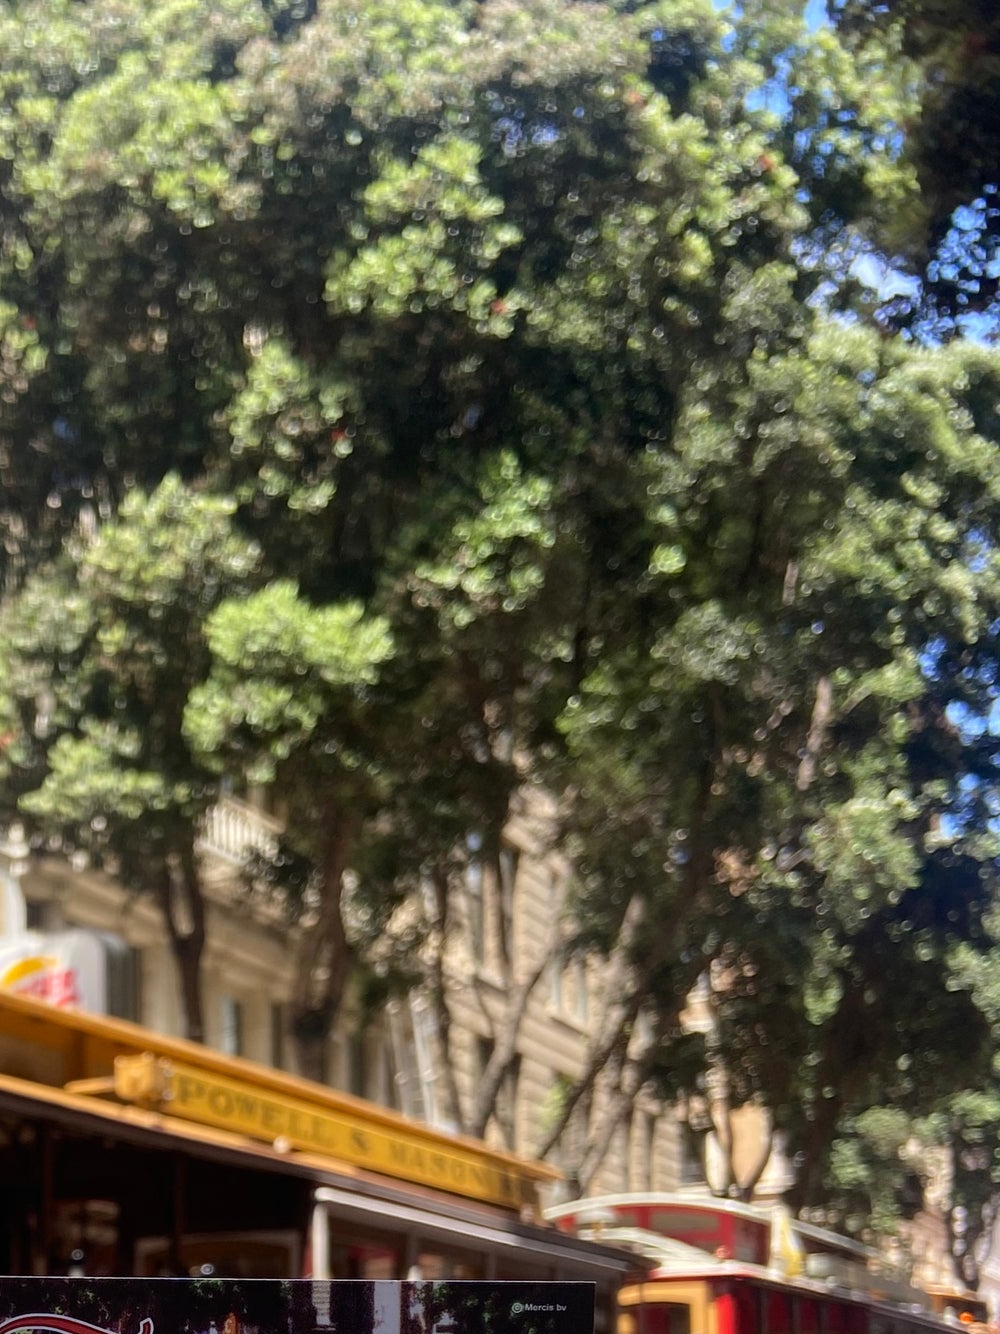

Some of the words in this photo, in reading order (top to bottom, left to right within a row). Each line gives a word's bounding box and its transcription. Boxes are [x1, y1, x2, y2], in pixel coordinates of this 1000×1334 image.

[178, 1074, 337, 1150] POWELL
[524, 1303, 555, 1312] Mercis
[556, 1303, 568, 1312] bv
